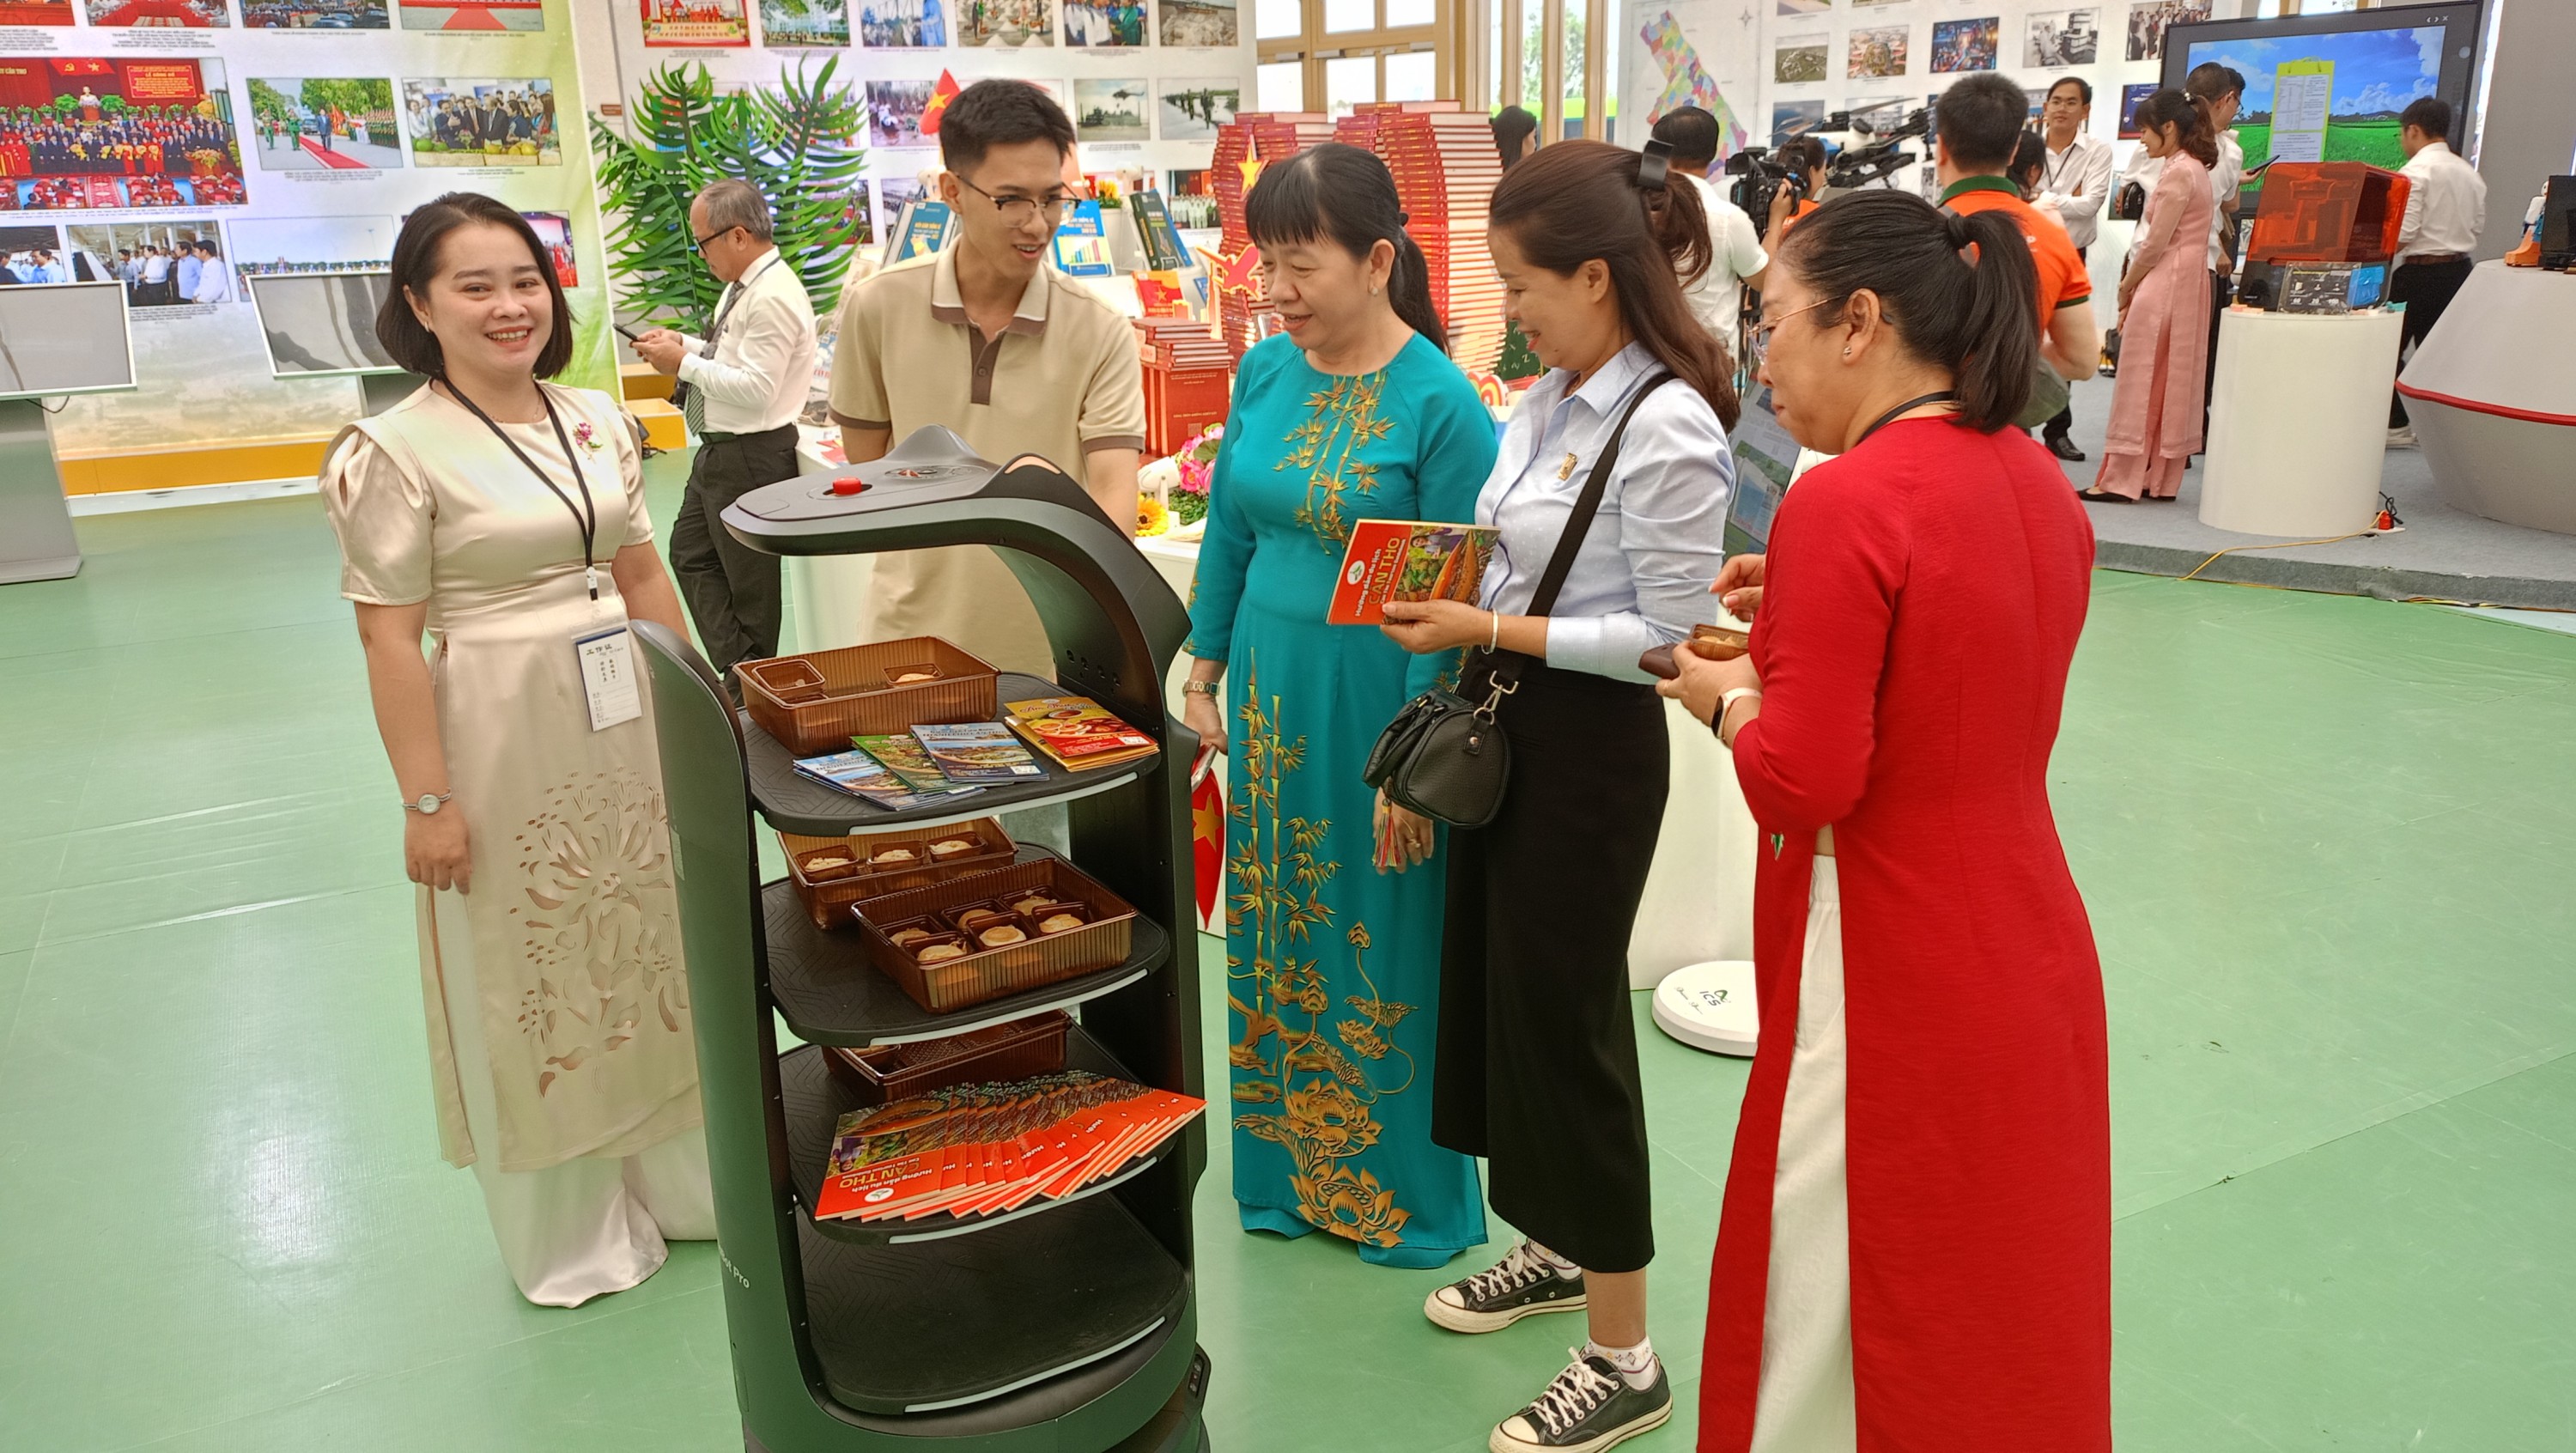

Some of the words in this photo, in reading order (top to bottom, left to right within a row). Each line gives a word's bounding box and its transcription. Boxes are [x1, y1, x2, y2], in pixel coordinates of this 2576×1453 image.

[1371, 549, 1382, 562] lịch
[1368, 563, 1376, 574] du
[1355, 590, 1368, 617] Hướng
[1698, 989, 1722, 1006] ICS
[902, 1168, 933, 1182] Hướng
[851, 1183, 870, 1193] lịch
[870, 1181, 883, 1189] du
[883, 1176, 902, 1188] dẫn
[732, 1265, 750, 1289] Pro
